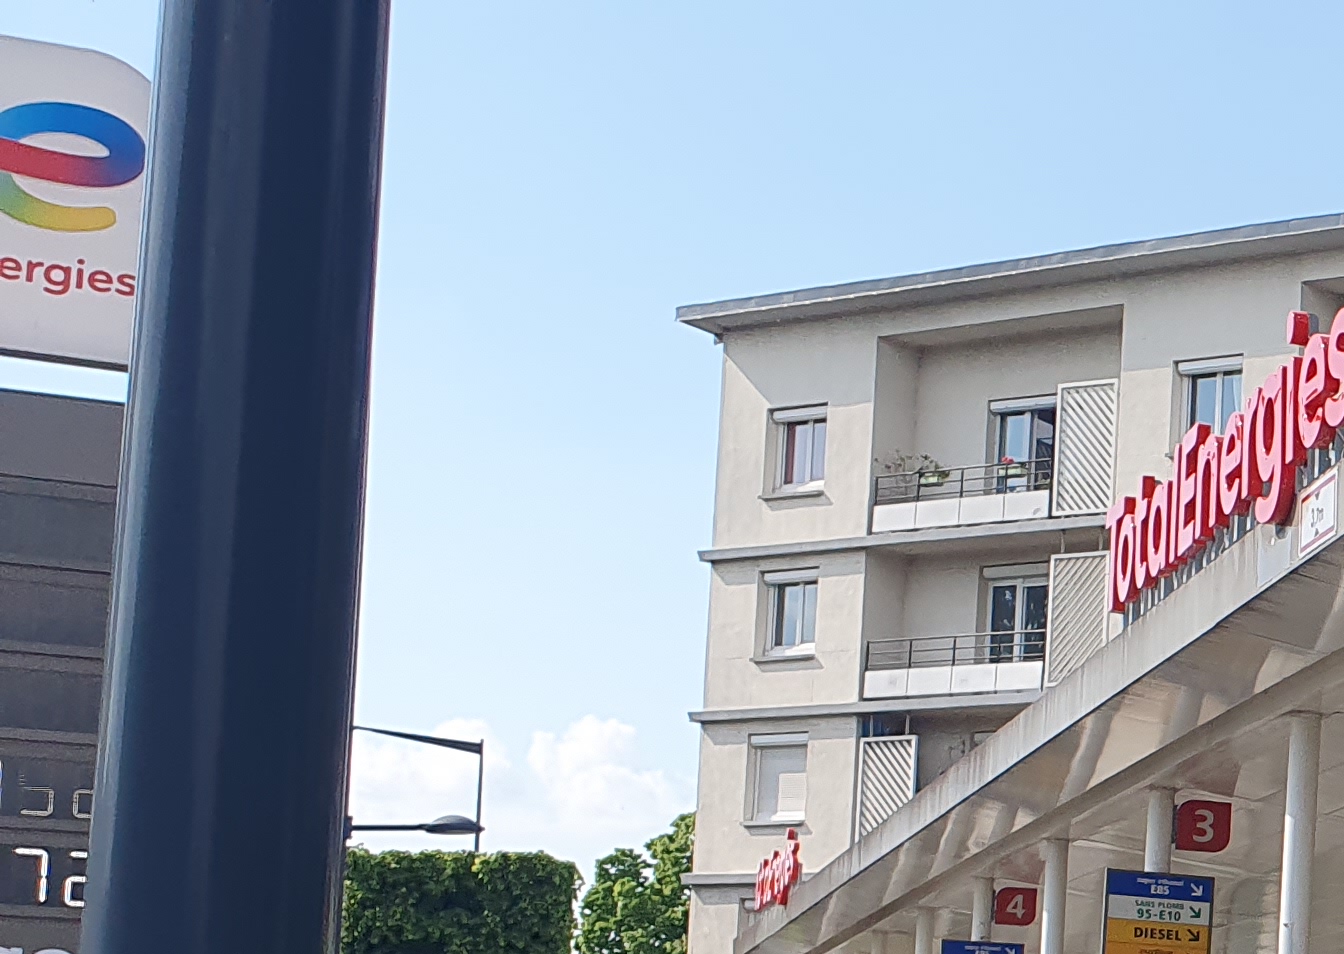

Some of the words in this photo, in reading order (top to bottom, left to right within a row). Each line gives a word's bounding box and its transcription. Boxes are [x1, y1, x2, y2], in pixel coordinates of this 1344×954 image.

[1193, 808, 1214, 843] 3
[1005, 894, 1026, 919] 4
[1137, 908, 1181, 921] 95-E10
[1134, 927, 1181, 941] DIESEL
